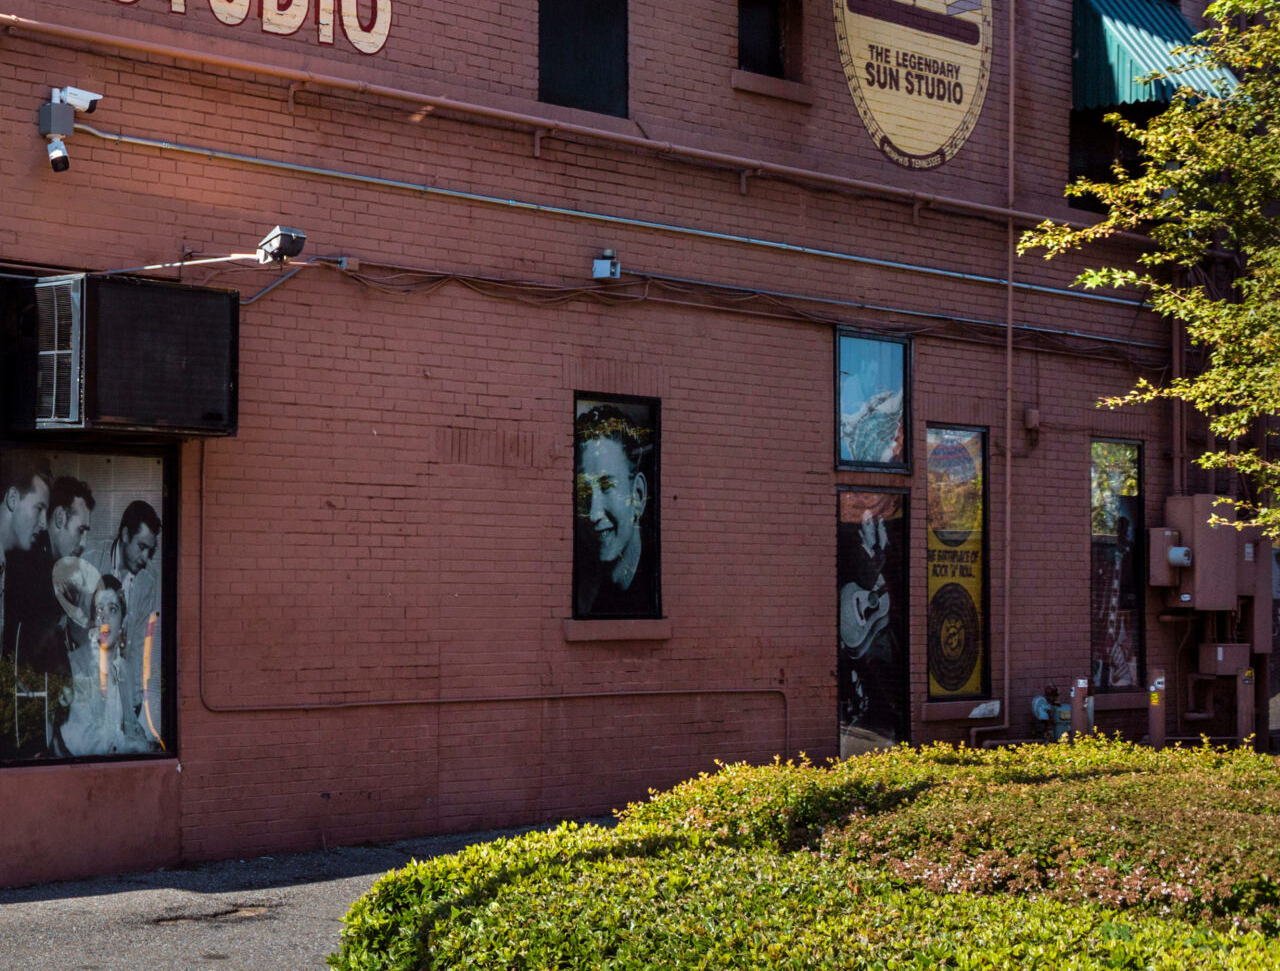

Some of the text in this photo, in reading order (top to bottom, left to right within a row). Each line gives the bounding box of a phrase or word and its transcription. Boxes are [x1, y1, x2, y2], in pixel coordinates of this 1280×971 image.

[867, 44, 961, 80] THE LEGENDARY
[865, 62, 963, 106] SUN STUDIO
